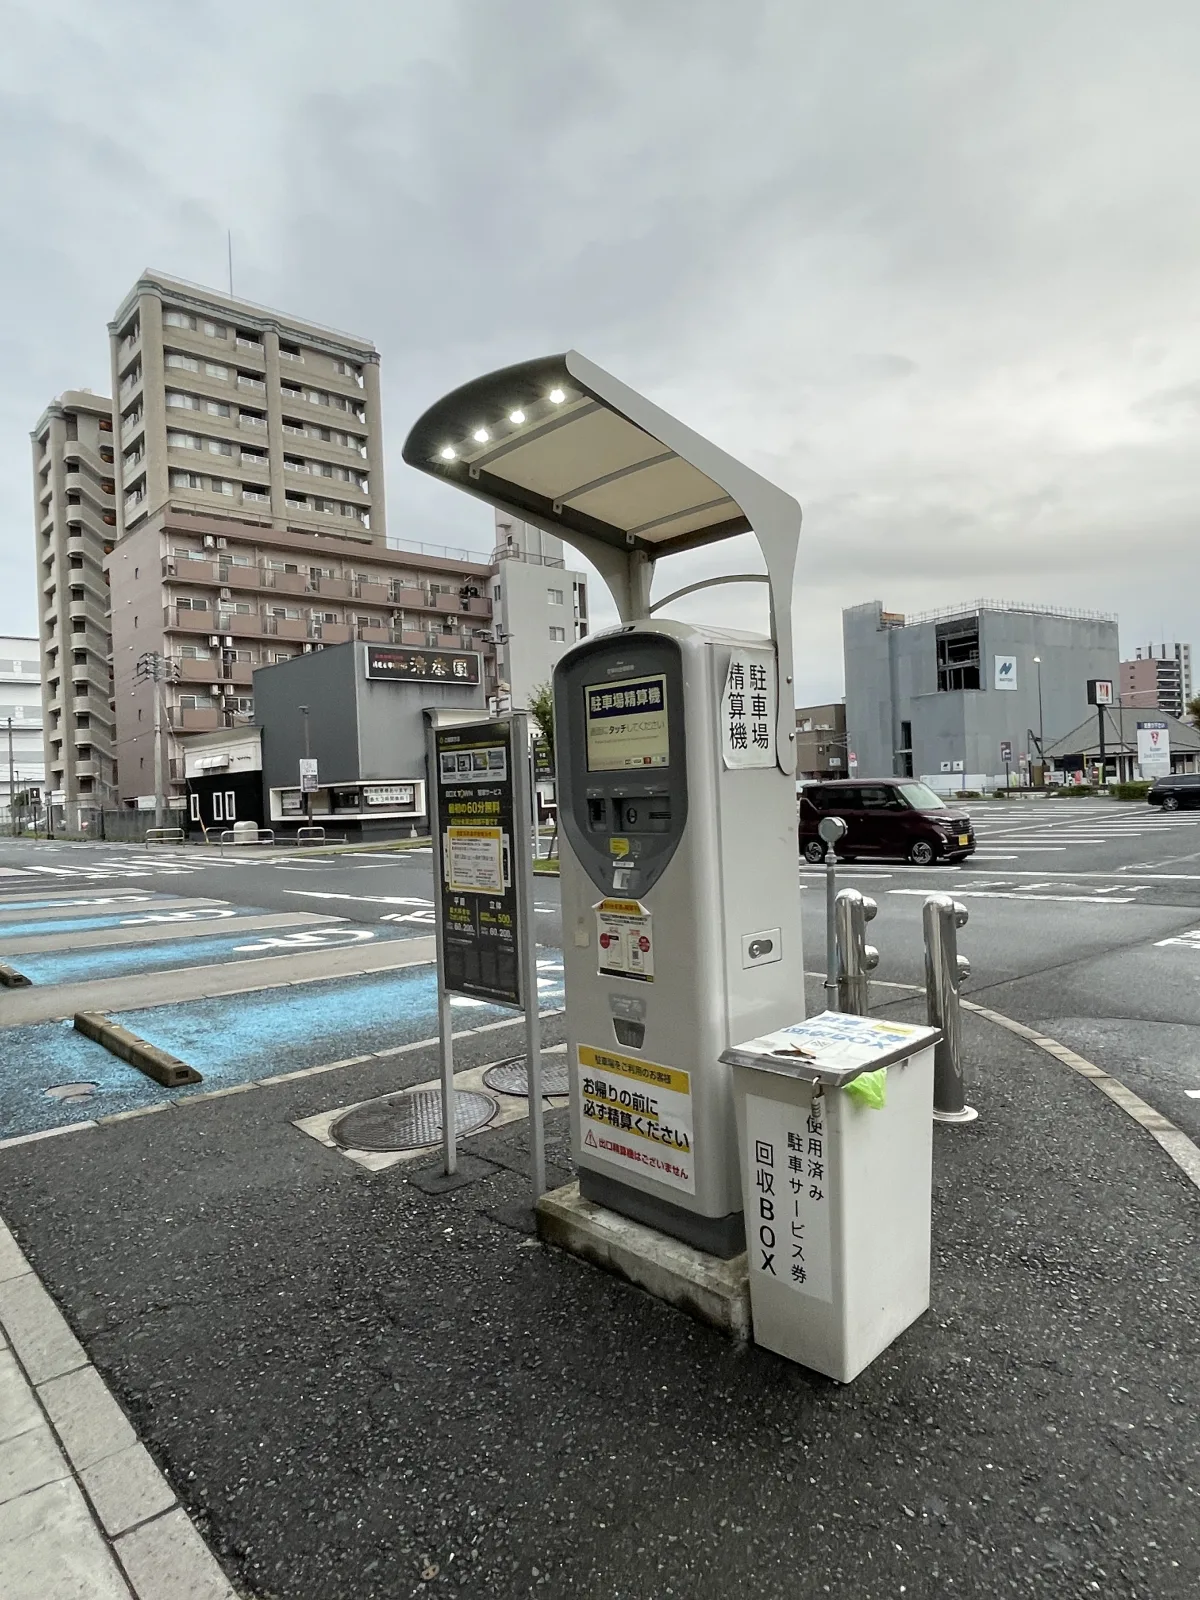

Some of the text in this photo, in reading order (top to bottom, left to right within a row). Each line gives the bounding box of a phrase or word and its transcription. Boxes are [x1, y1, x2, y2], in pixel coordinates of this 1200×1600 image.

[590, 686, 661, 713] 駐車場精算機
[728, 662, 748, 750] 精算機
[749, 664, 769, 750] 駐車場
[448, 801, 500, 814] 最初の60分無料
[594, 1054, 672, 1085] 駐車場をご利用のお客様
[582, 1077, 659, 1117] お帰りの前に
[583, 1098, 690, 1149] 必ず精算ください
[598, 1137, 690, 1180] 出口精算機はございません
[805, 1115, 825, 1201] 使用済み
[755, 1140, 778, 1277] 回収BOX
[787, 1131, 807, 1285] 駐車サービス券
